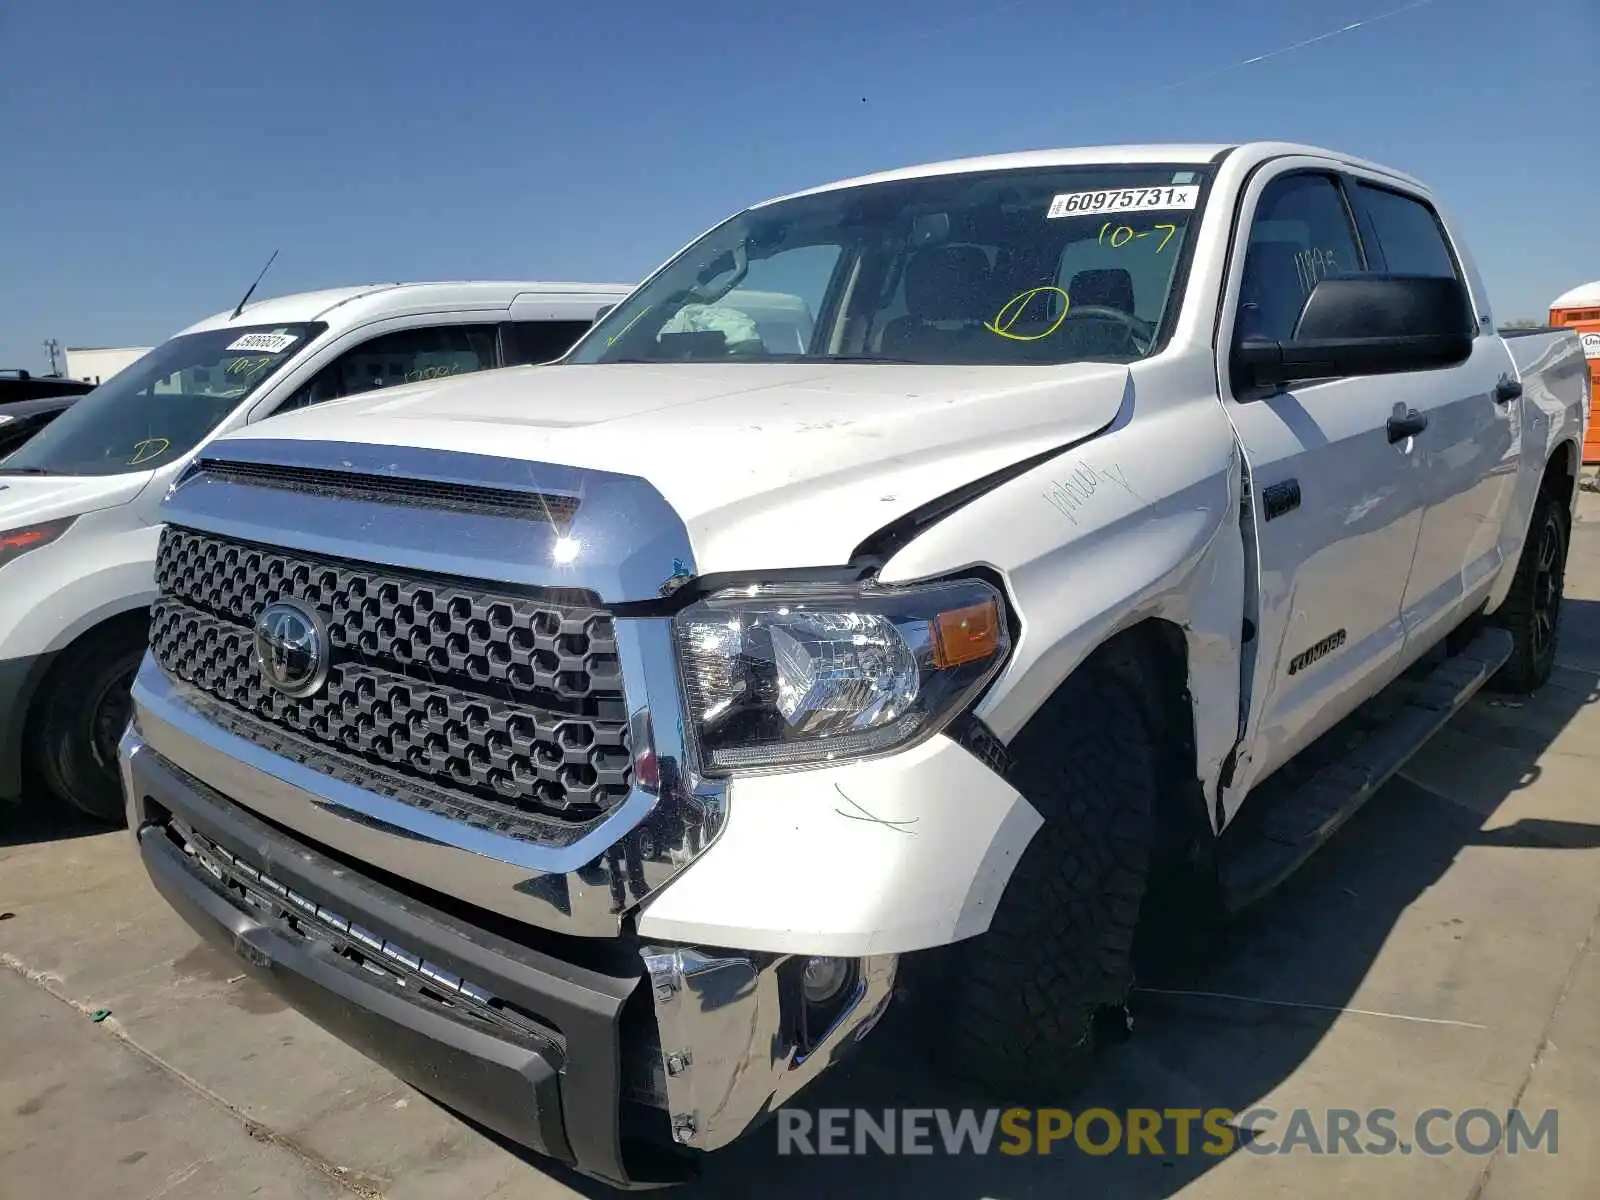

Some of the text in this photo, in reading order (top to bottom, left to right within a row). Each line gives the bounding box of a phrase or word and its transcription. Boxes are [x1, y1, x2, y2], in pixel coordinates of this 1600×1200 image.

[1098, 222, 1176, 254] 10-7
[126, 438, 169, 465] D
[1288, 628, 1347, 676] TUNDRA
